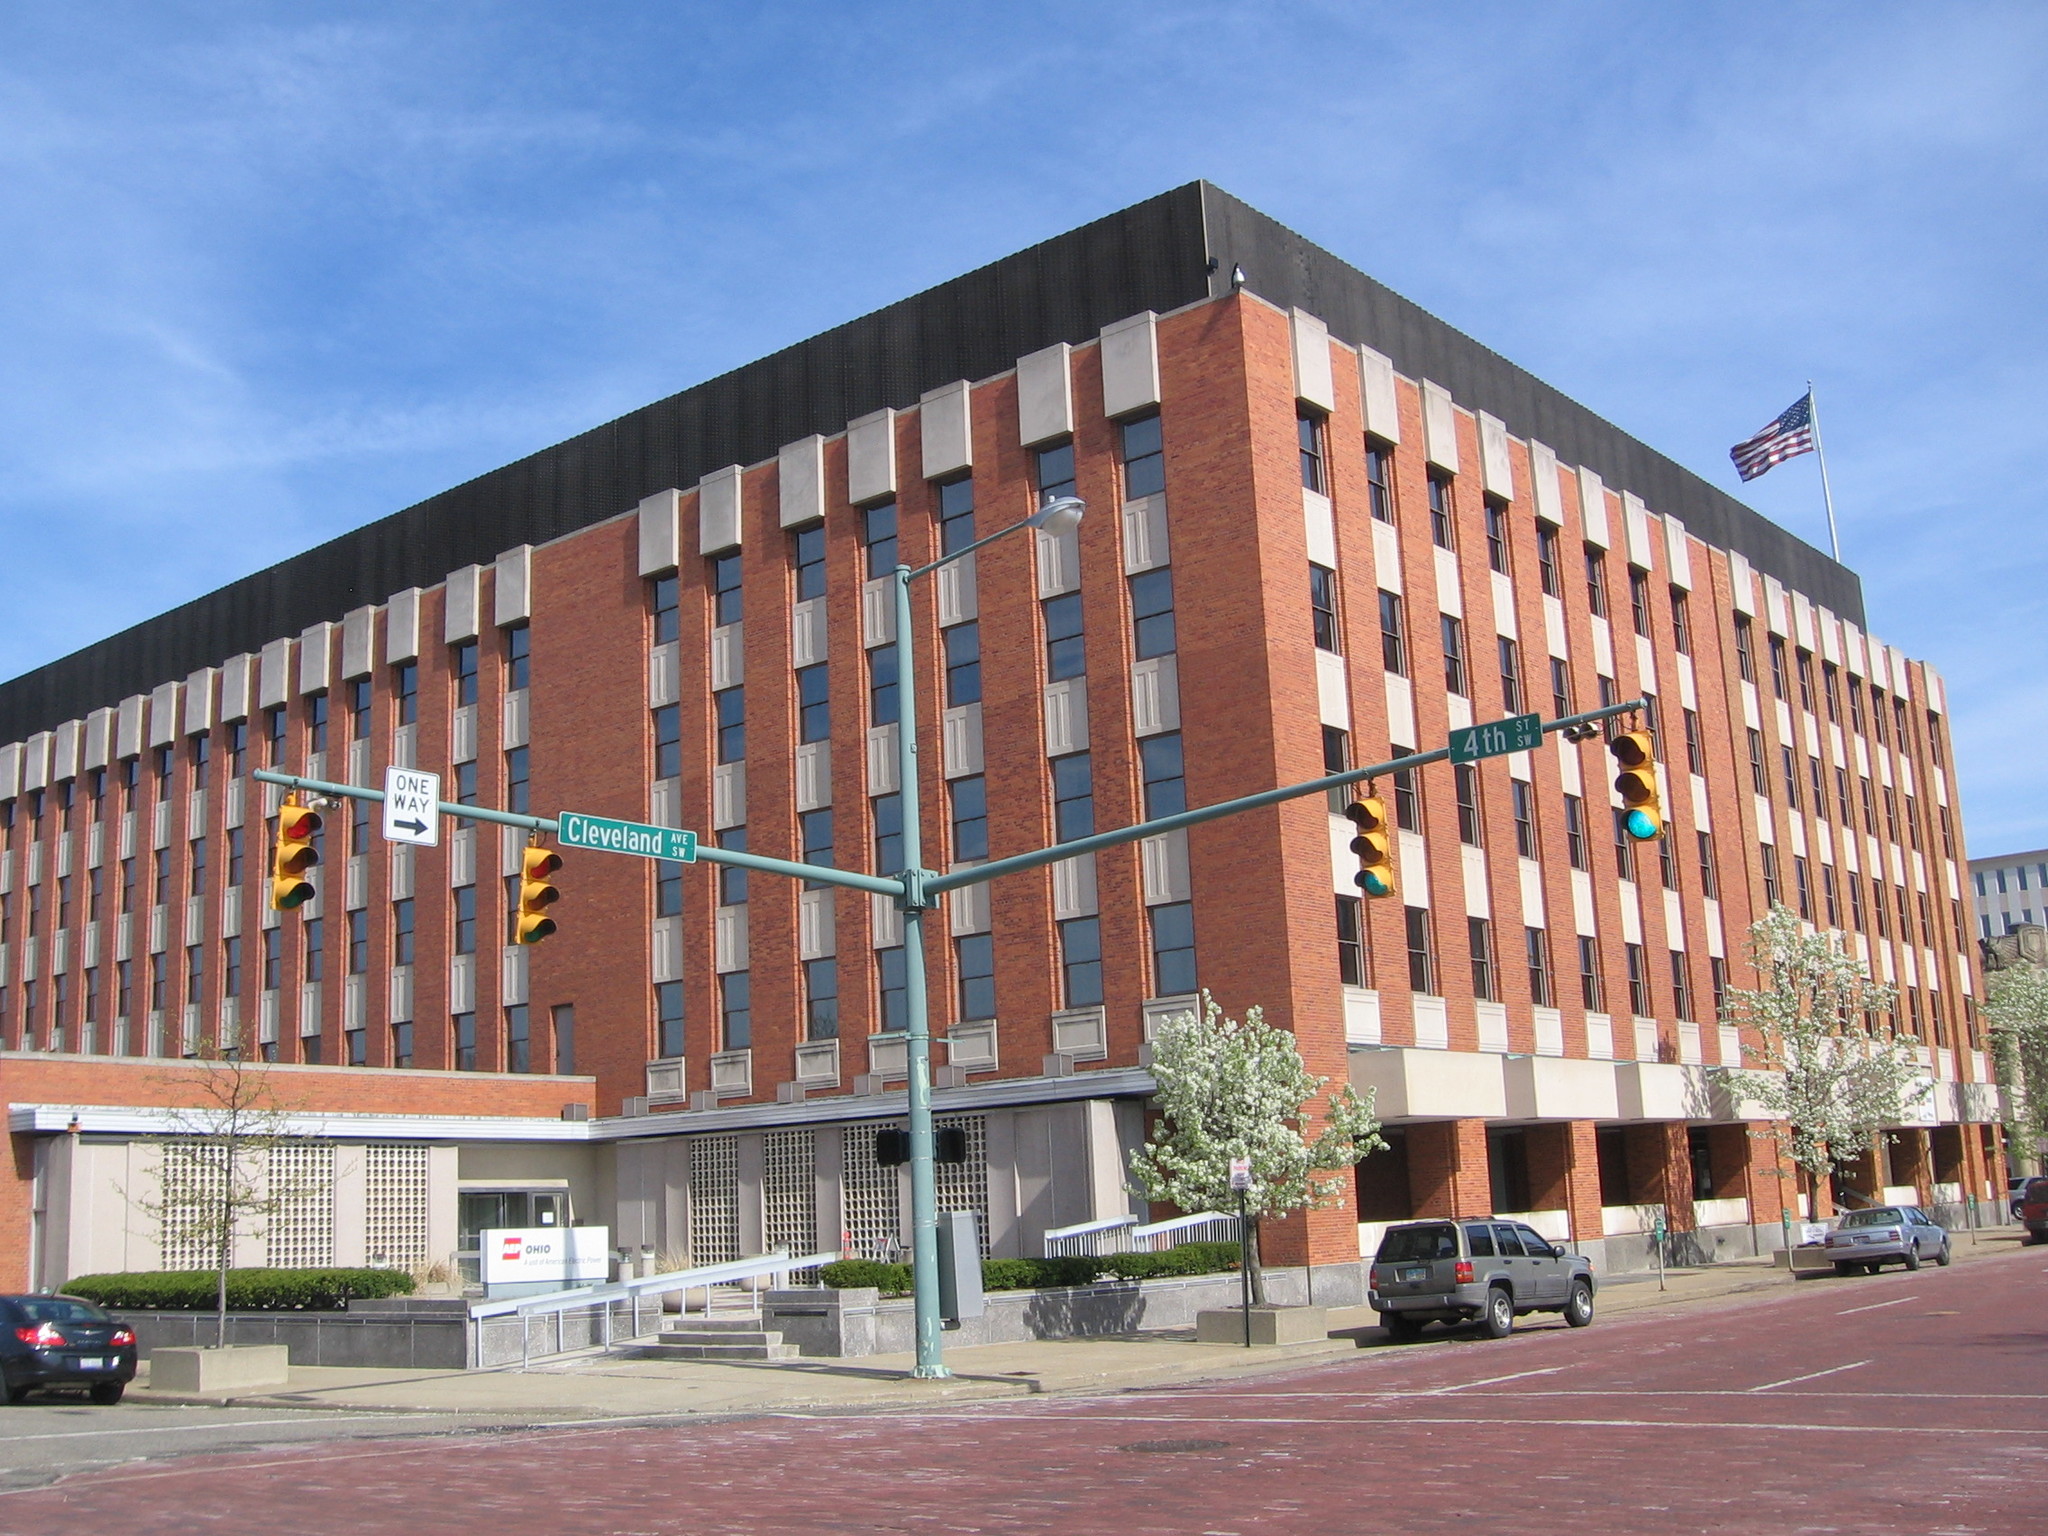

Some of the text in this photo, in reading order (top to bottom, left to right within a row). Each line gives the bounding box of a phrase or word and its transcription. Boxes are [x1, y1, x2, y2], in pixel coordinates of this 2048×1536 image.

[1515, 718, 1530, 732] ST
[1463, 726, 1507, 757] 4th
[1517, 735, 1533, 747] SW
[396, 774, 430, 795] ONE
[393, 794, 430, 814] WAY
[567, 817, 662, 854] Cleveland
[669, 833, 689, 846] AVE
[671, 846, 686, 858] SW
[525, 1244, 551, 1255] OHIO
[539, 1257, 546, 1266] of
[545, 1257, 567, 1265] American
[586, 1256, 602, 1265] Power
